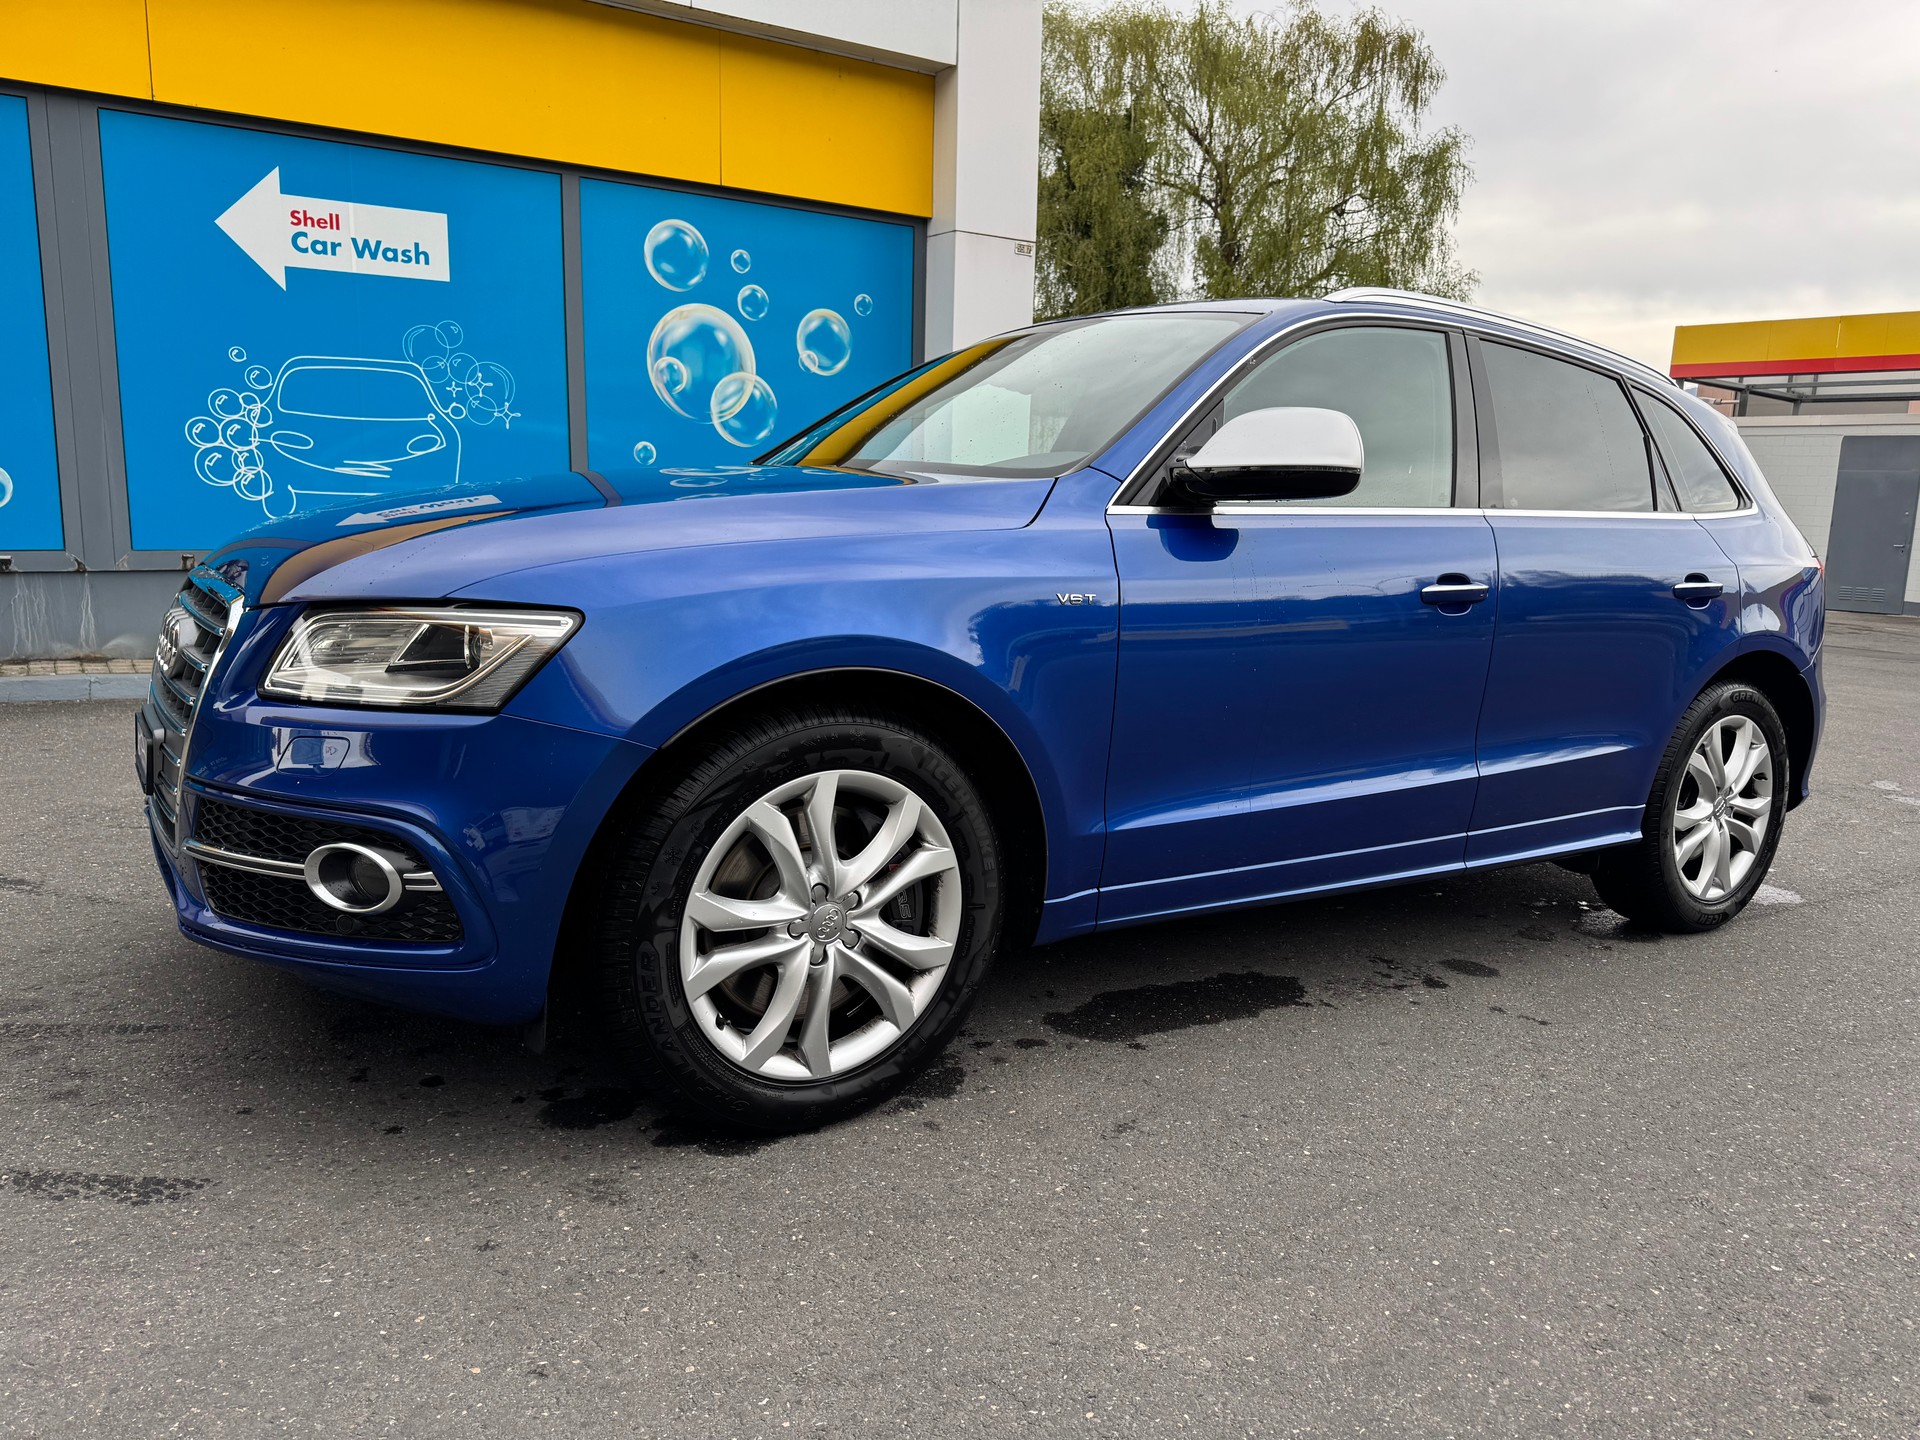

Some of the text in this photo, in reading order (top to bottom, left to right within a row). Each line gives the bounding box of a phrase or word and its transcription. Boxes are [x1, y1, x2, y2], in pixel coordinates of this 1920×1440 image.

[290, 210, 340, 231] Shell
[291, 231, 430, 265] Car Wash
[1056, 593, 1097, 605] V6T
